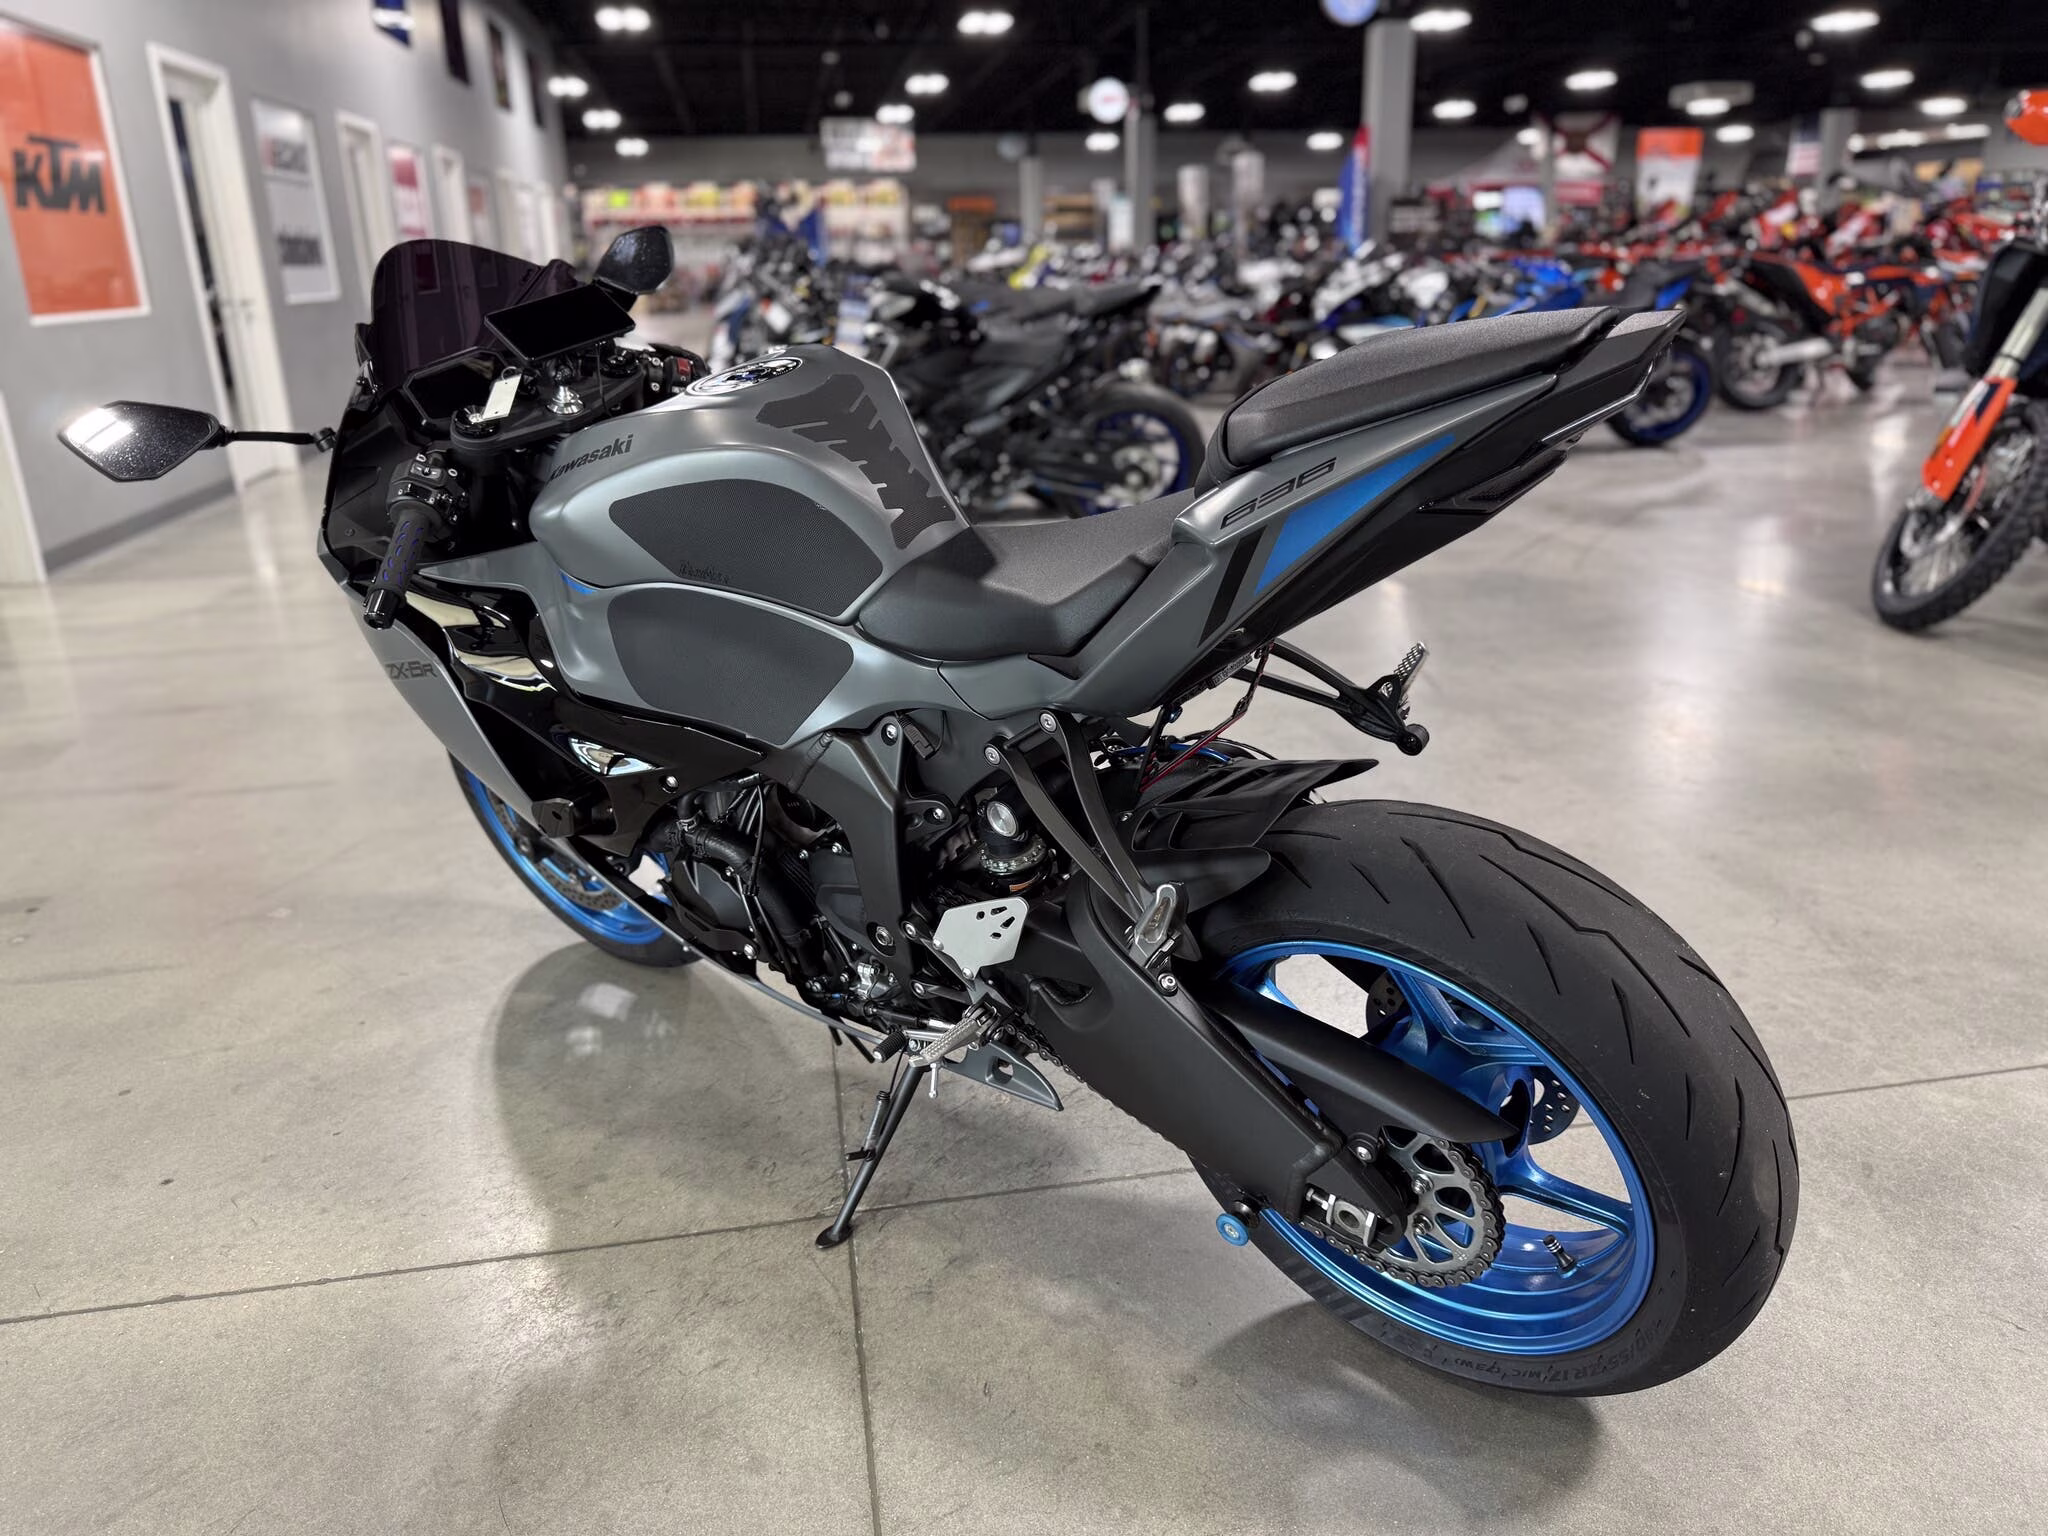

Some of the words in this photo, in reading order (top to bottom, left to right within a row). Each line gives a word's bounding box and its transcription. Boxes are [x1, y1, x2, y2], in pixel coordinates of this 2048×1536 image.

[13, 134, 106, 214] KTM
[1220, 457, 1337, 529] 636
[385, 661, 438, 679] ZX-6R
